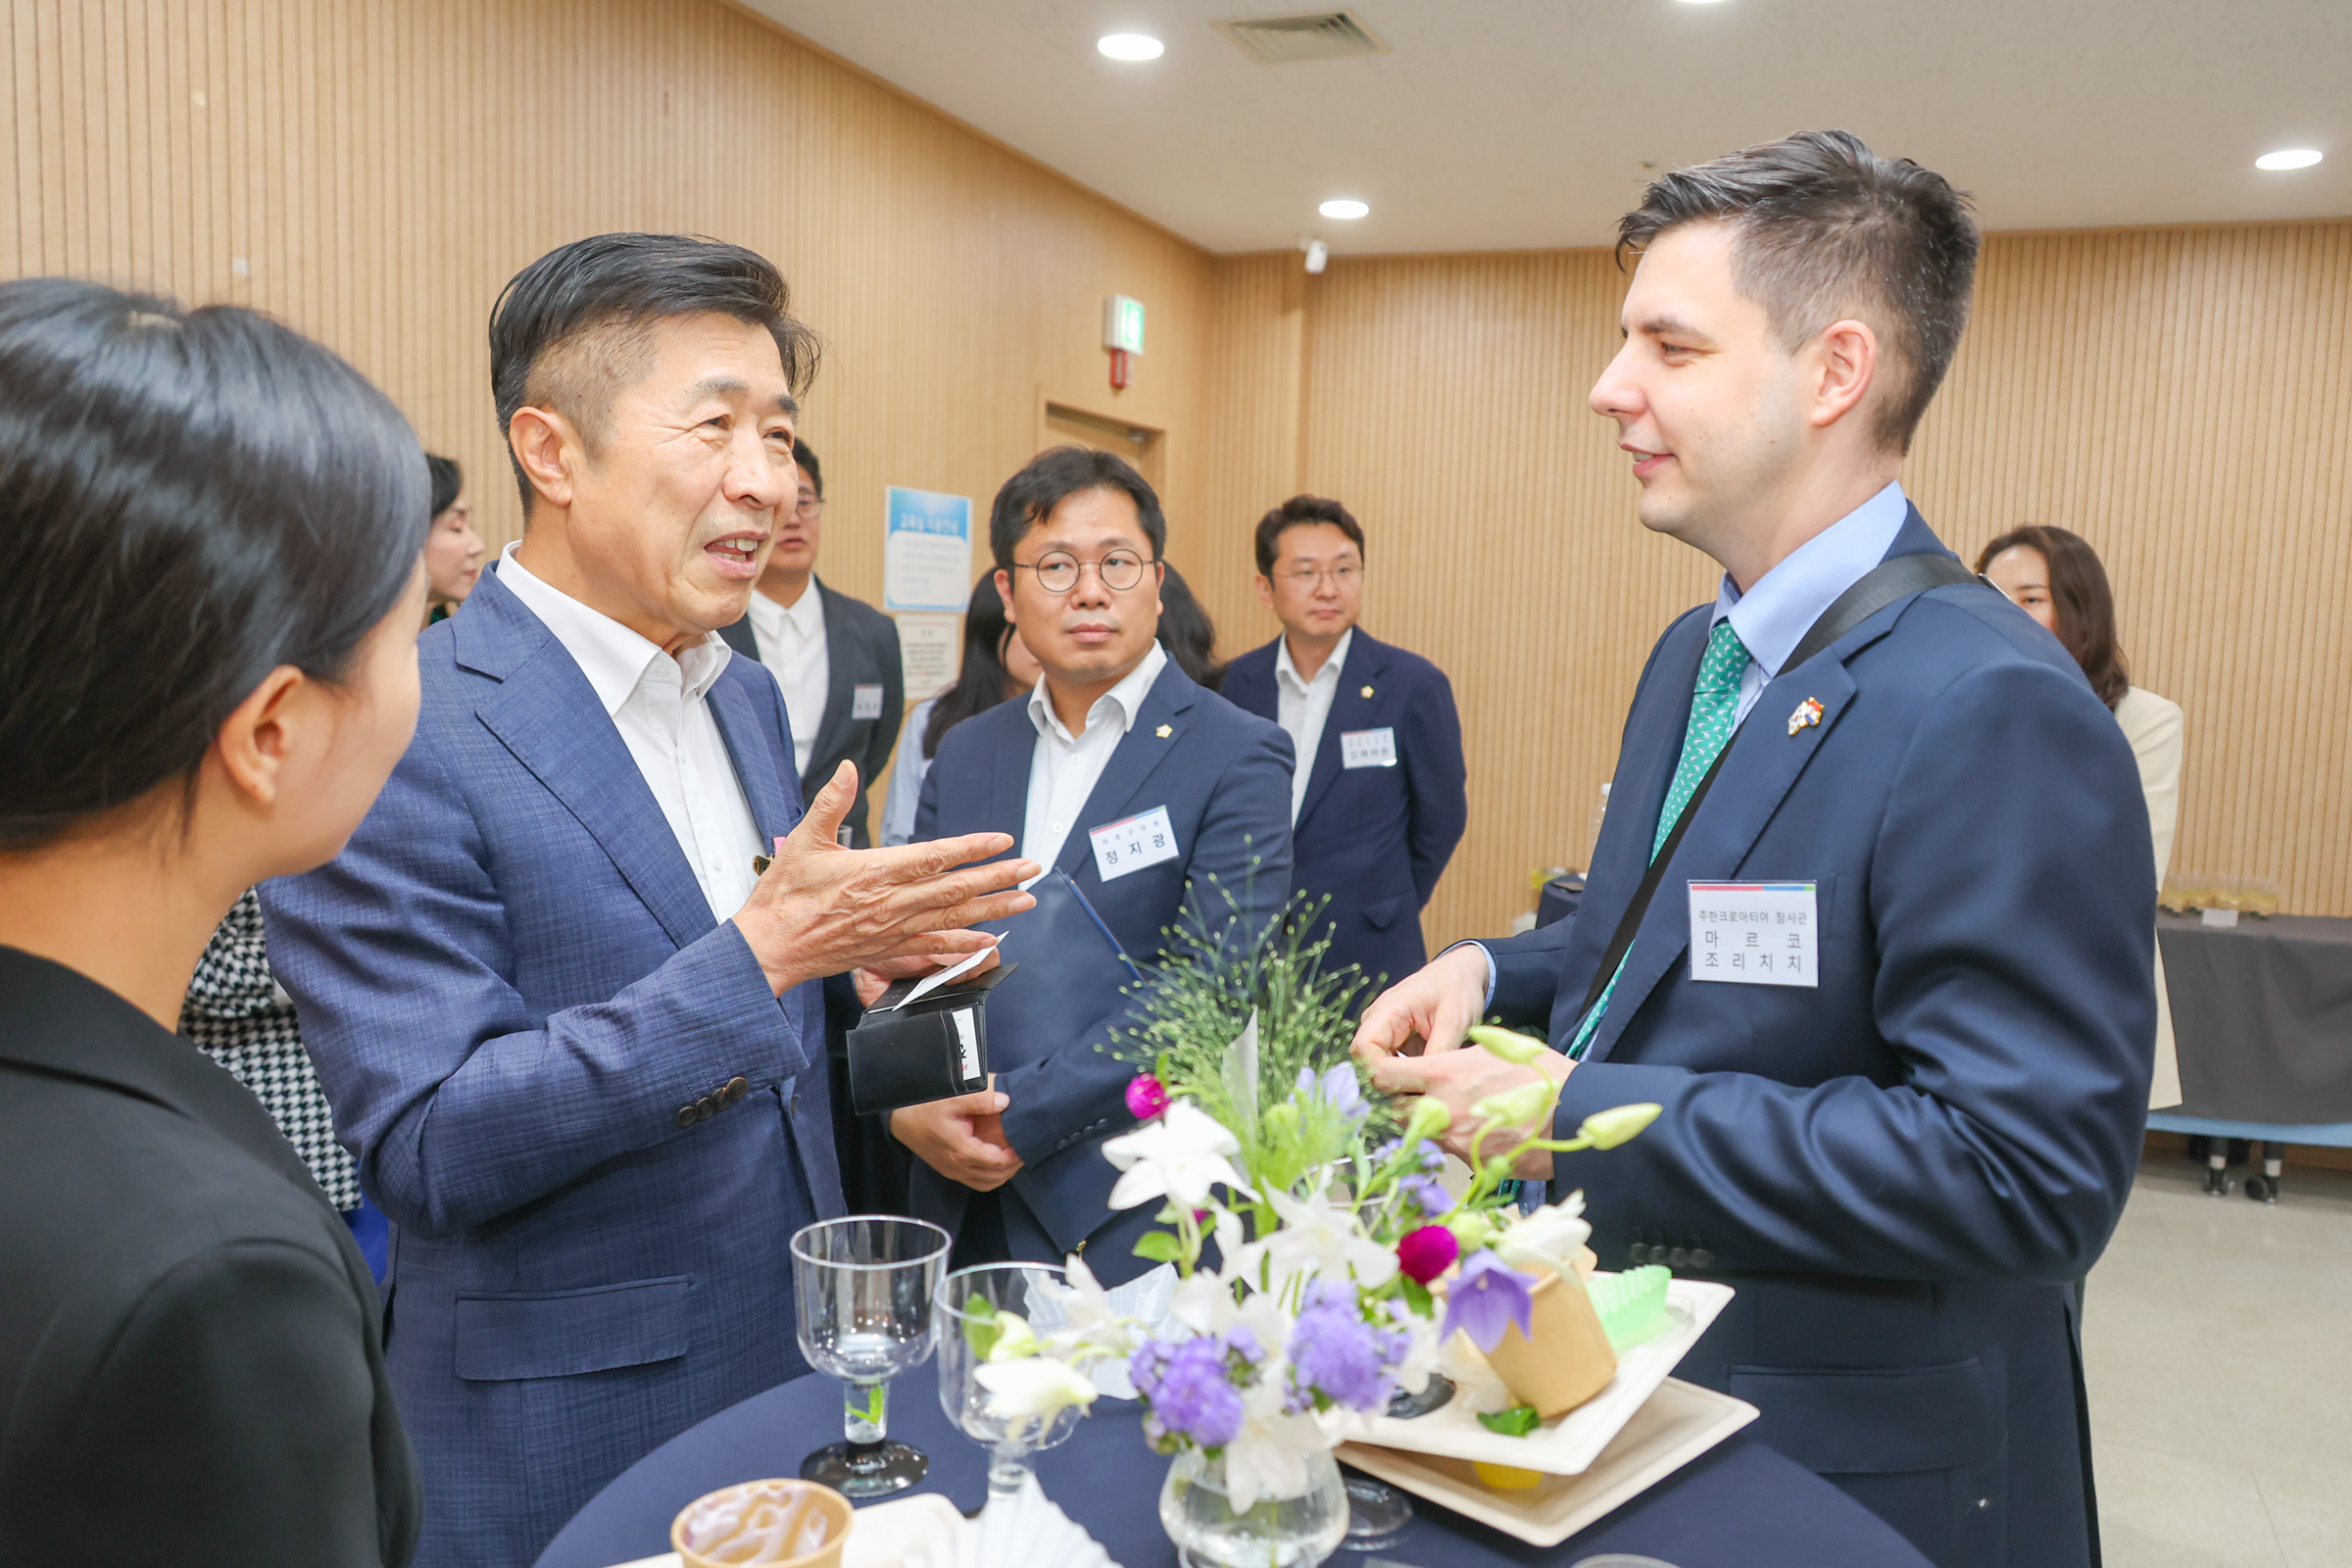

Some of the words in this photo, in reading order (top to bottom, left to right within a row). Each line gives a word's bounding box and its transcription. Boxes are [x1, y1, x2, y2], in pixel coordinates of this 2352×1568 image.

[1105, 832, 1166, 864] 정지광
[1698, 909, 1770, 924] 주한크로아티아
[1776, 911, 1808, 925] 참사관
[1705, 930, 1802, 949] 마르코
[1705, 952, 1802, 973] 조리치치
